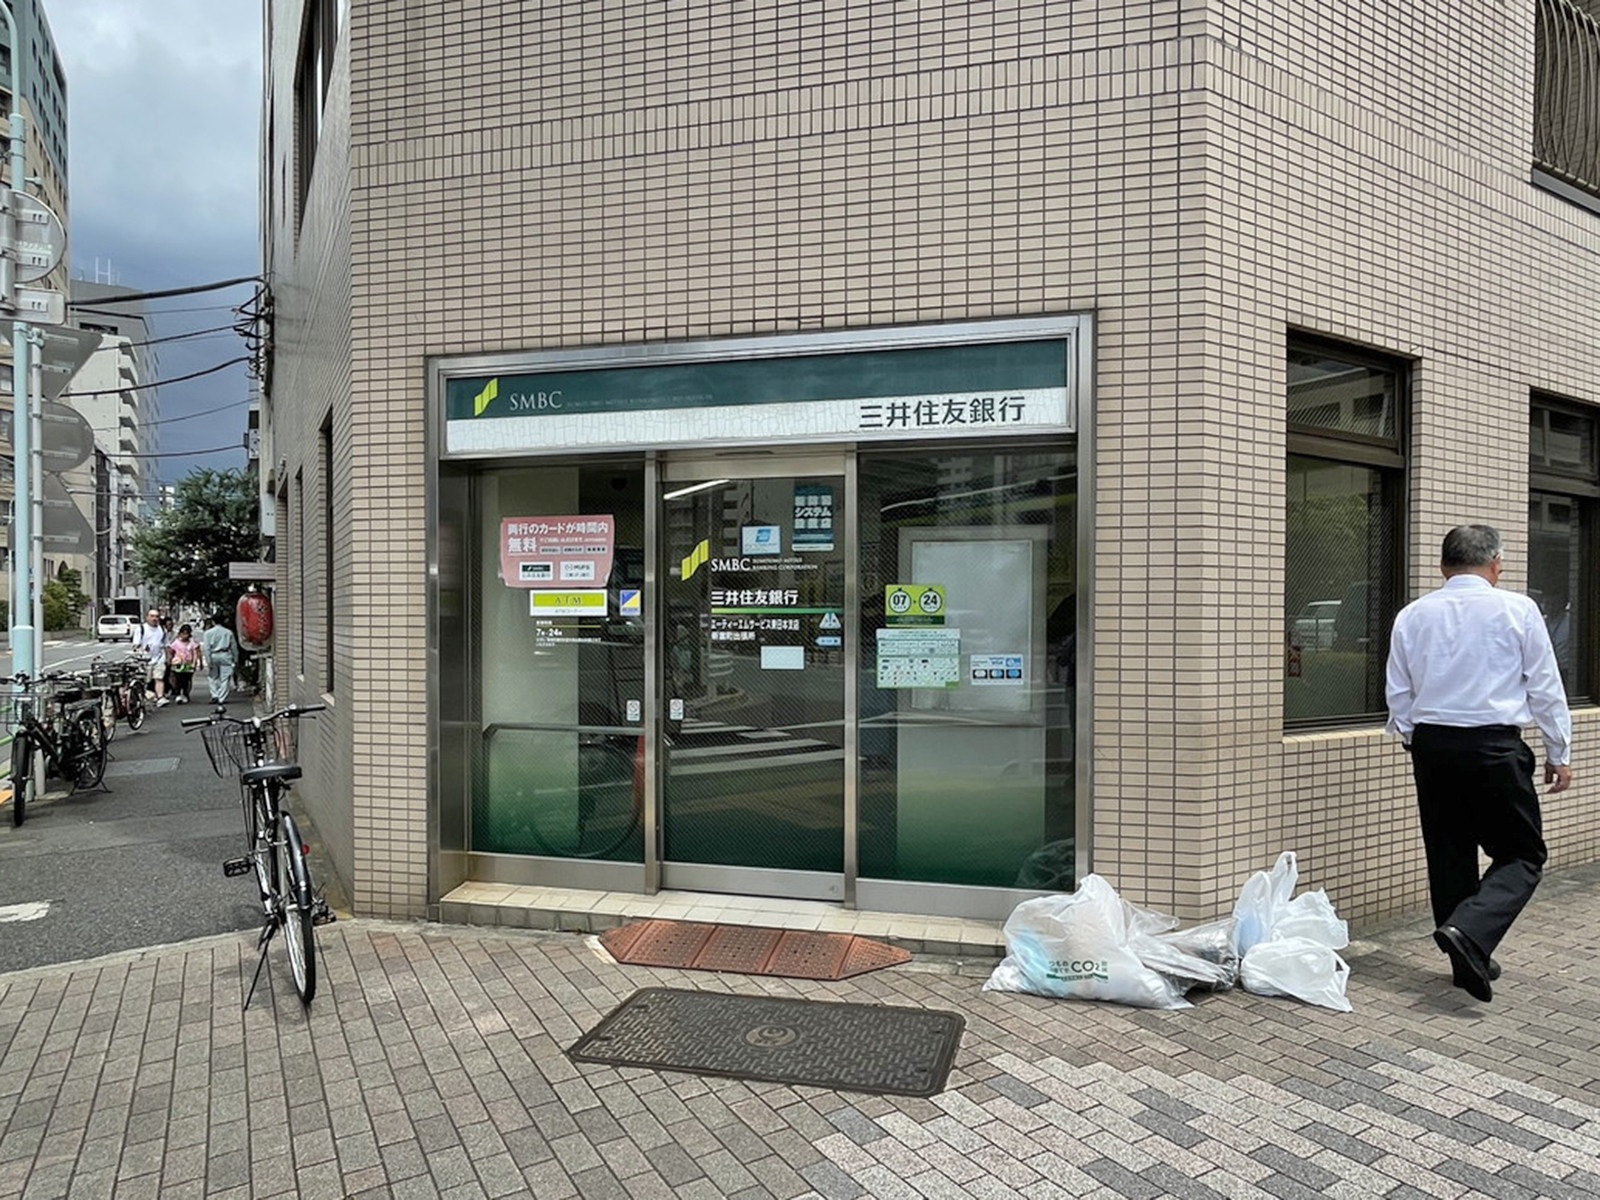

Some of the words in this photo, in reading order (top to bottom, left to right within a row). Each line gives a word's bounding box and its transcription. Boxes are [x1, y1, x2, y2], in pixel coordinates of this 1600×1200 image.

[509, 390, 563, 411] SMBC
[858, 396, 1026, 428] 三井住友銀行
[710, 557, 752, 572] SMBC
[710, 589, 799, 606] 三井住友銀行
[892, 595, 908, 606] 07
[923, 595, 939, 606] 24
